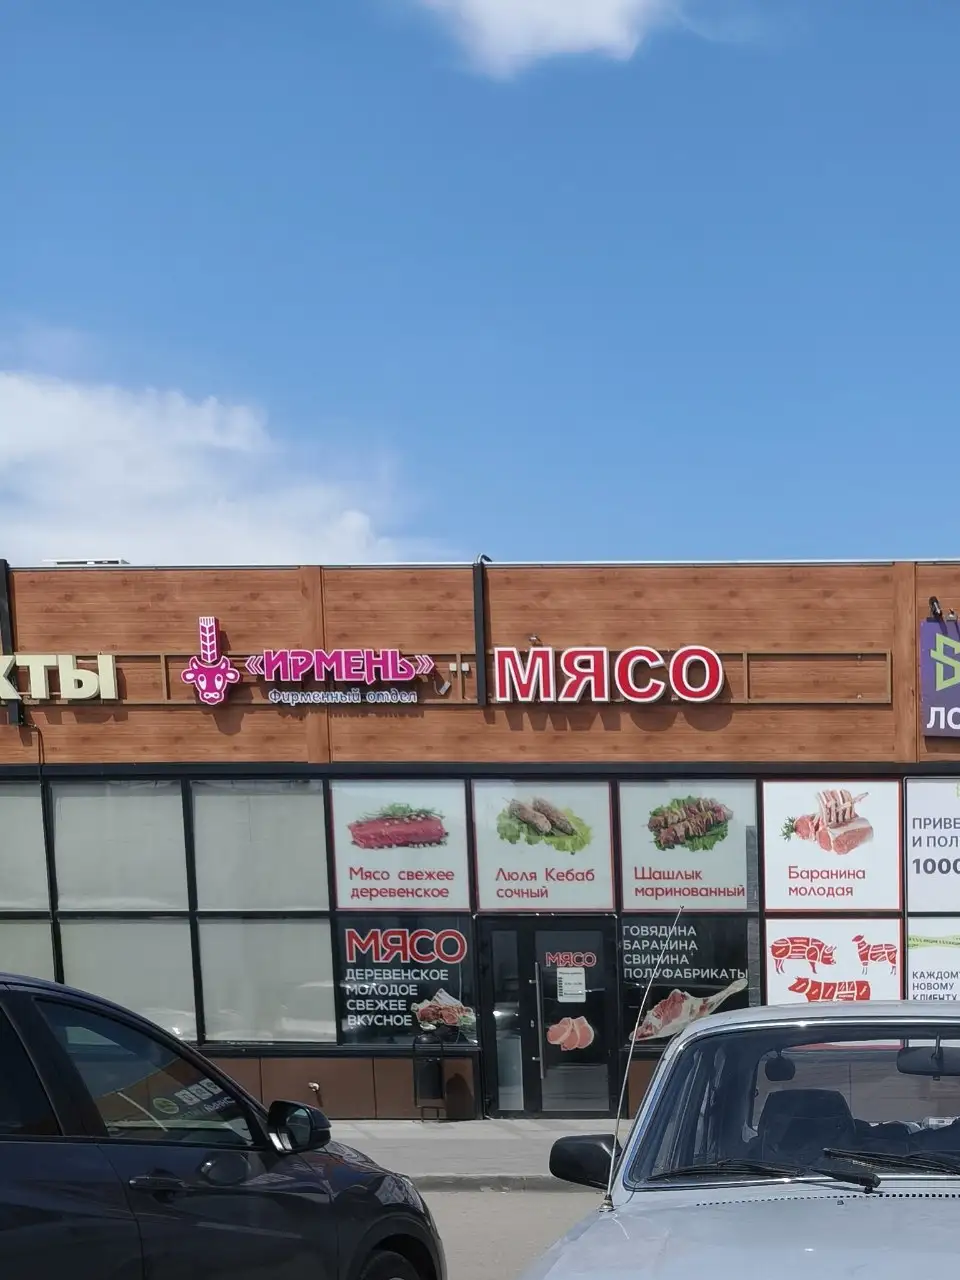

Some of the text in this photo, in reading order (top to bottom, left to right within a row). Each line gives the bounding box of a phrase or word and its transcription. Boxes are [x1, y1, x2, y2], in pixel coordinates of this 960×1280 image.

[494, 645, 723, 703] МЯСО
[269, 688, 418, 706] Фирменный отдел
[912, 836, 922, 847] И
[349, 867, 455, 881] Мясо свежее
[495, 868, 595, 882] Люля Кебаб
[634, 866, 703, 880] Шашлык
[788, 866, 866, 882] Баранина
[350, 887, 449, 901] деревенское
[496, 886, 549, 898] сочный
[634, 884, 745, 900] маринованный
[788, 886, 854, 898] молодая
[622, 925, 697, 938] ГОВЯДИНА
[345, 928, 468, 964] МЯСО
[622, 939, 698, 951] БАРАНИНА
[545, 951, 597, 968] МЯСО
[623, 953, 690, 965] СВИНИНА
[345, 968, 449, 981] ДЕРЕВЕНСКОЕ
[623, 967, 749, 980] ПОЛУФАБРИКАТЫ
[345, 984, 418, 997] МОЛОДОЕ
[912, 982, 955, 991] НОВОМУ
[346, 999, 407, 1011] СВЕЖЕЕ
[347, 1014, 412, 1026] ВКУСНОЕ
